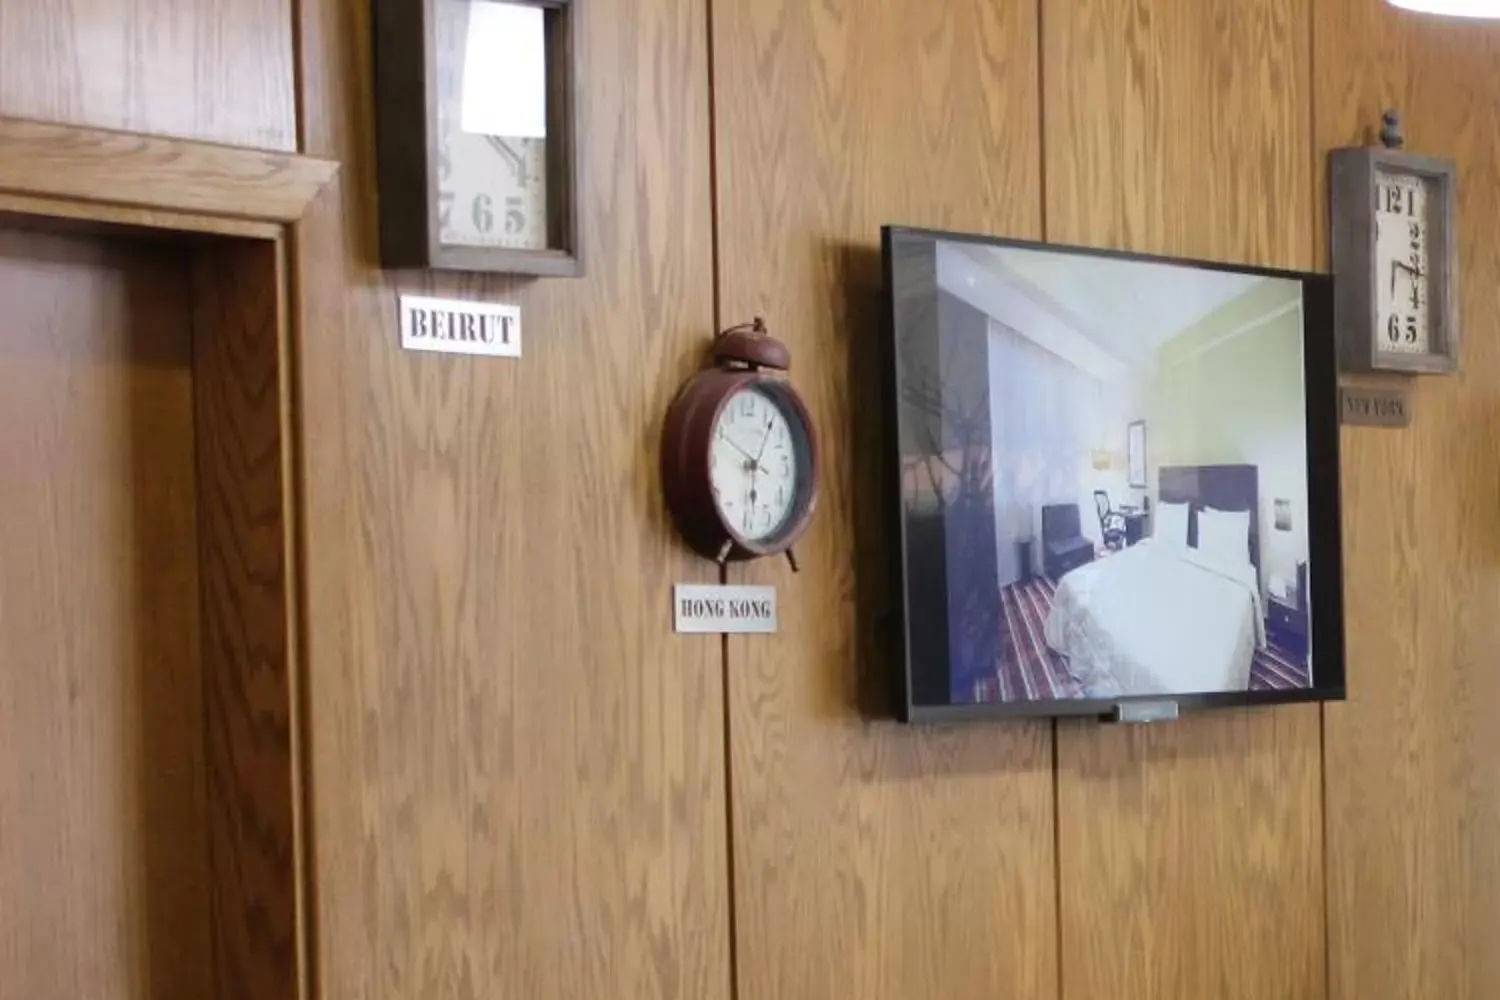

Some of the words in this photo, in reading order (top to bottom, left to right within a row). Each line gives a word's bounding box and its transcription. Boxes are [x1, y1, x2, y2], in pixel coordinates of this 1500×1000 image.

[471, 193, 494, 234] 6
[504, 196, 526, 234] 5
[409, 307, 514, 345] BEIRUT
[1387, 313, 1400, 343] 6
[1405, 315, 1417, 344] 5
[681, 599, 725, 618] HONG
[729, 599, 771, 619] KONG
